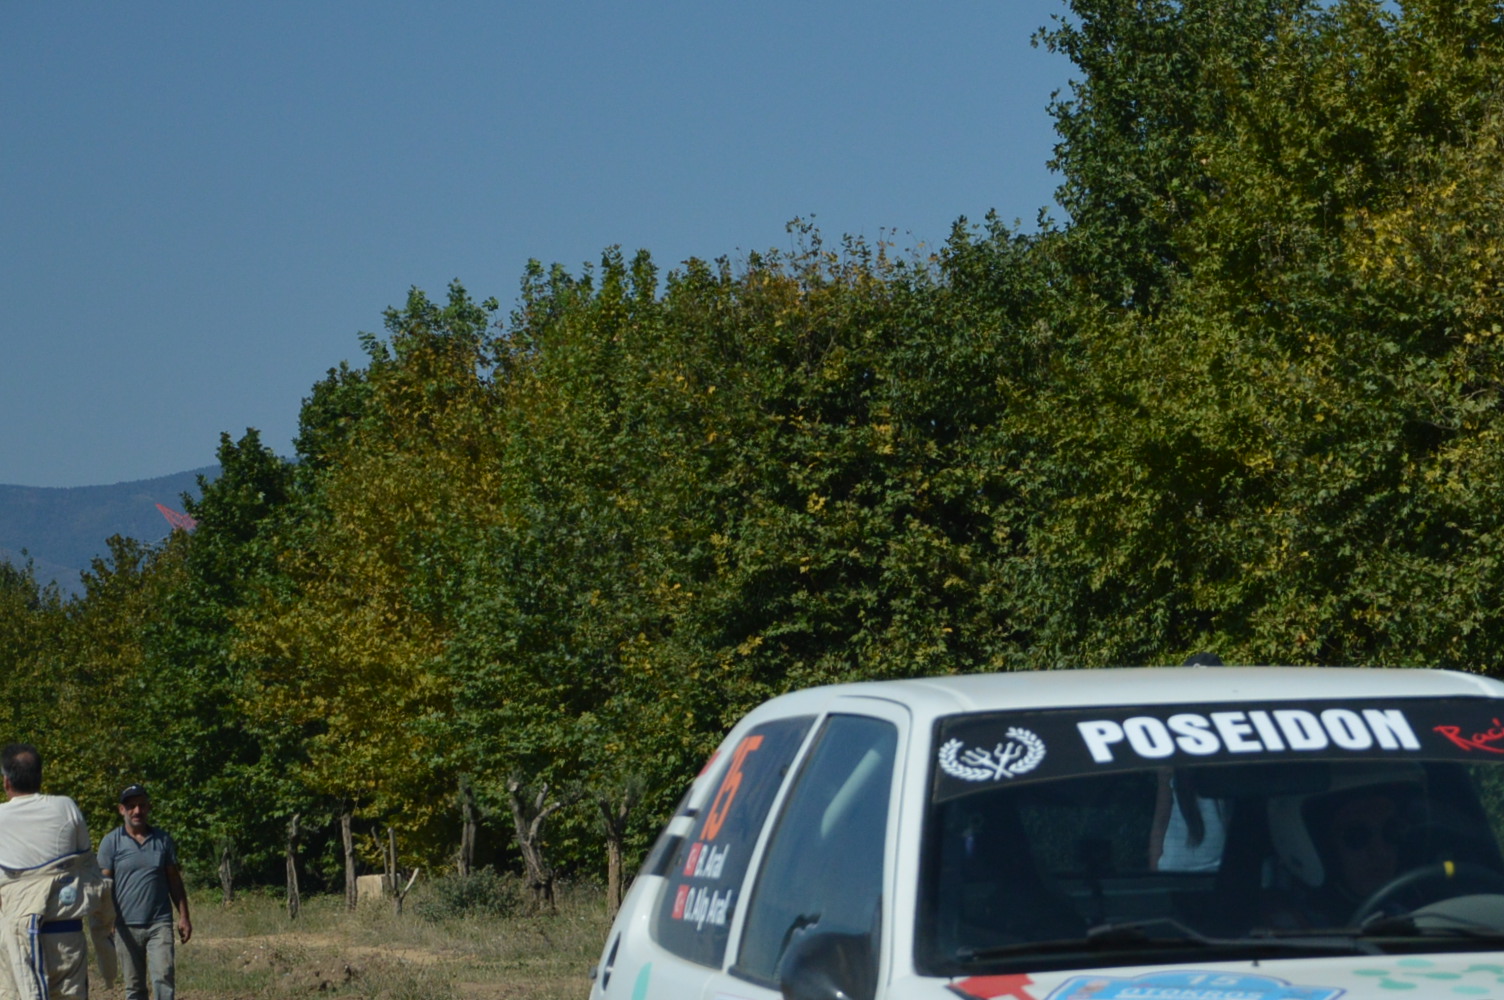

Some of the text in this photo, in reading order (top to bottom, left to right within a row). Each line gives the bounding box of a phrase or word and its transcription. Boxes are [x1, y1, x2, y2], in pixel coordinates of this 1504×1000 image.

[1077, 708, 1421, 764] POSEIDON
[706, 889, 733, 925] Aral
[1184, 974, 1240, 986] 15
